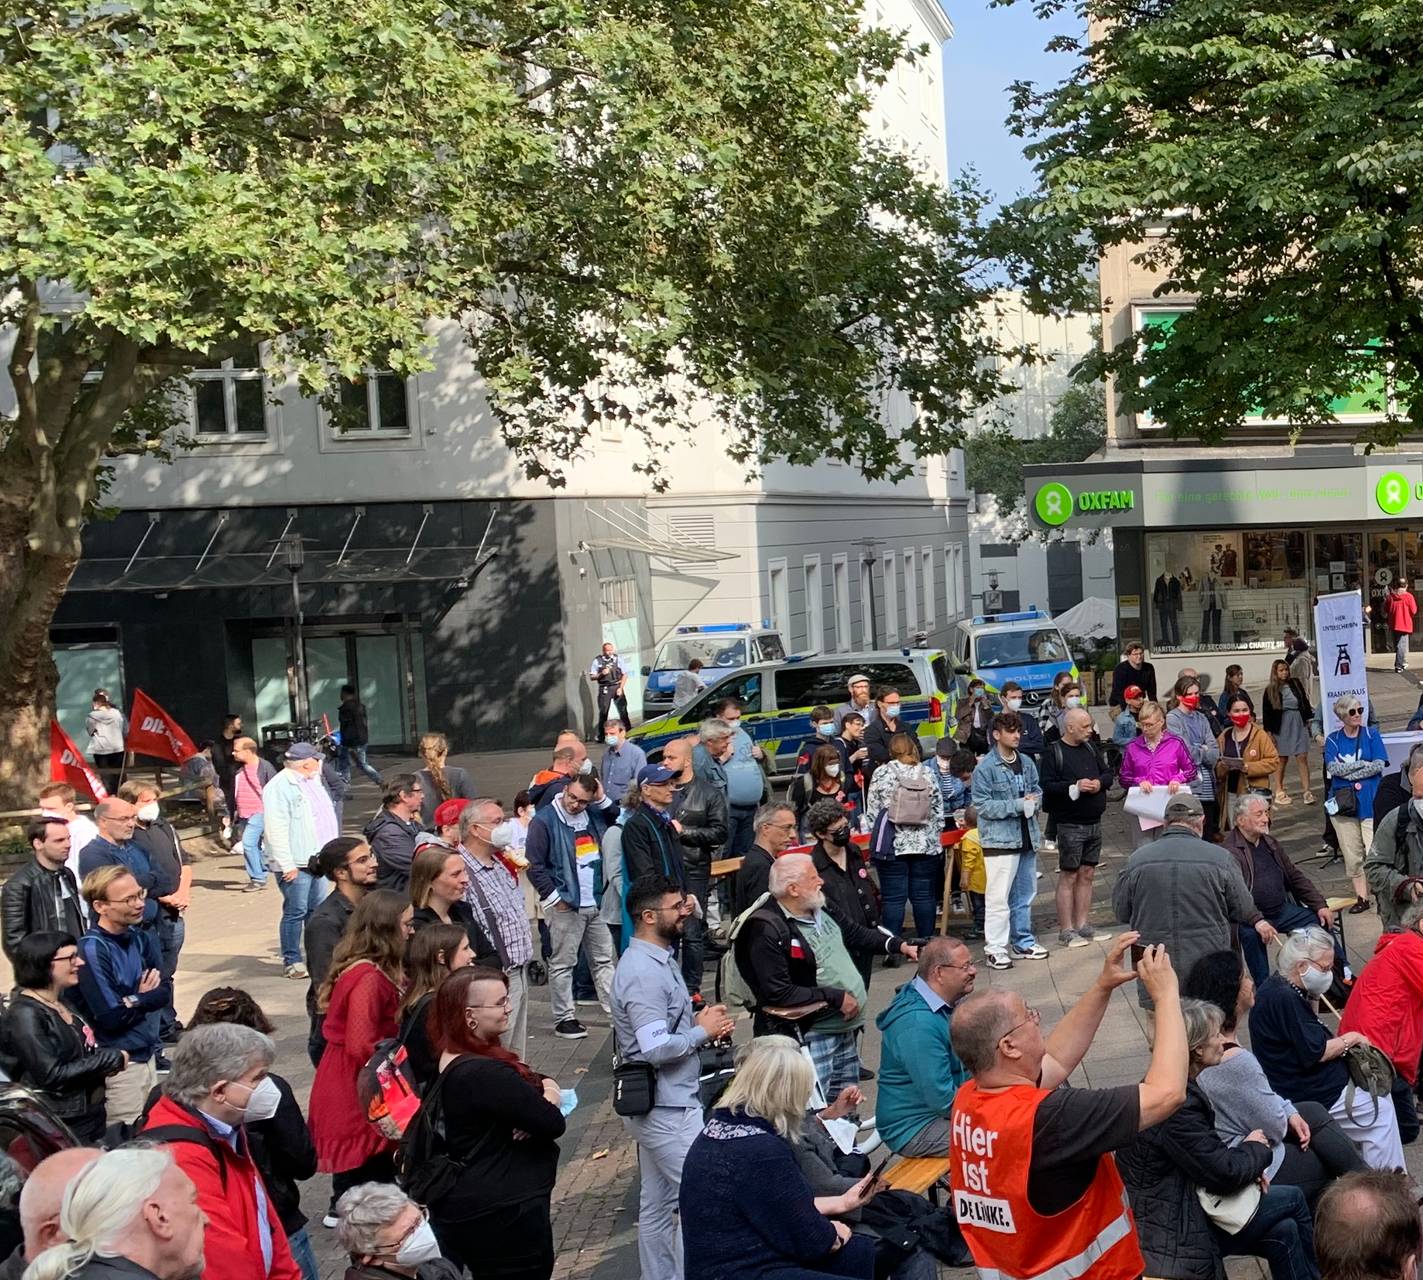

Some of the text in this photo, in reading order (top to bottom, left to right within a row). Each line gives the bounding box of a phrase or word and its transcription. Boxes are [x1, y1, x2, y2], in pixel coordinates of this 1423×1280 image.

[1079, 490, 1134, 511] OXFAM
[1248, 640, 1275, 650] CHARITY
[1005, 673, 1051, 681] POLIZEI
[953, 1109, 999, 1158] Hier
[962, 1151, 992, 1195] ist
